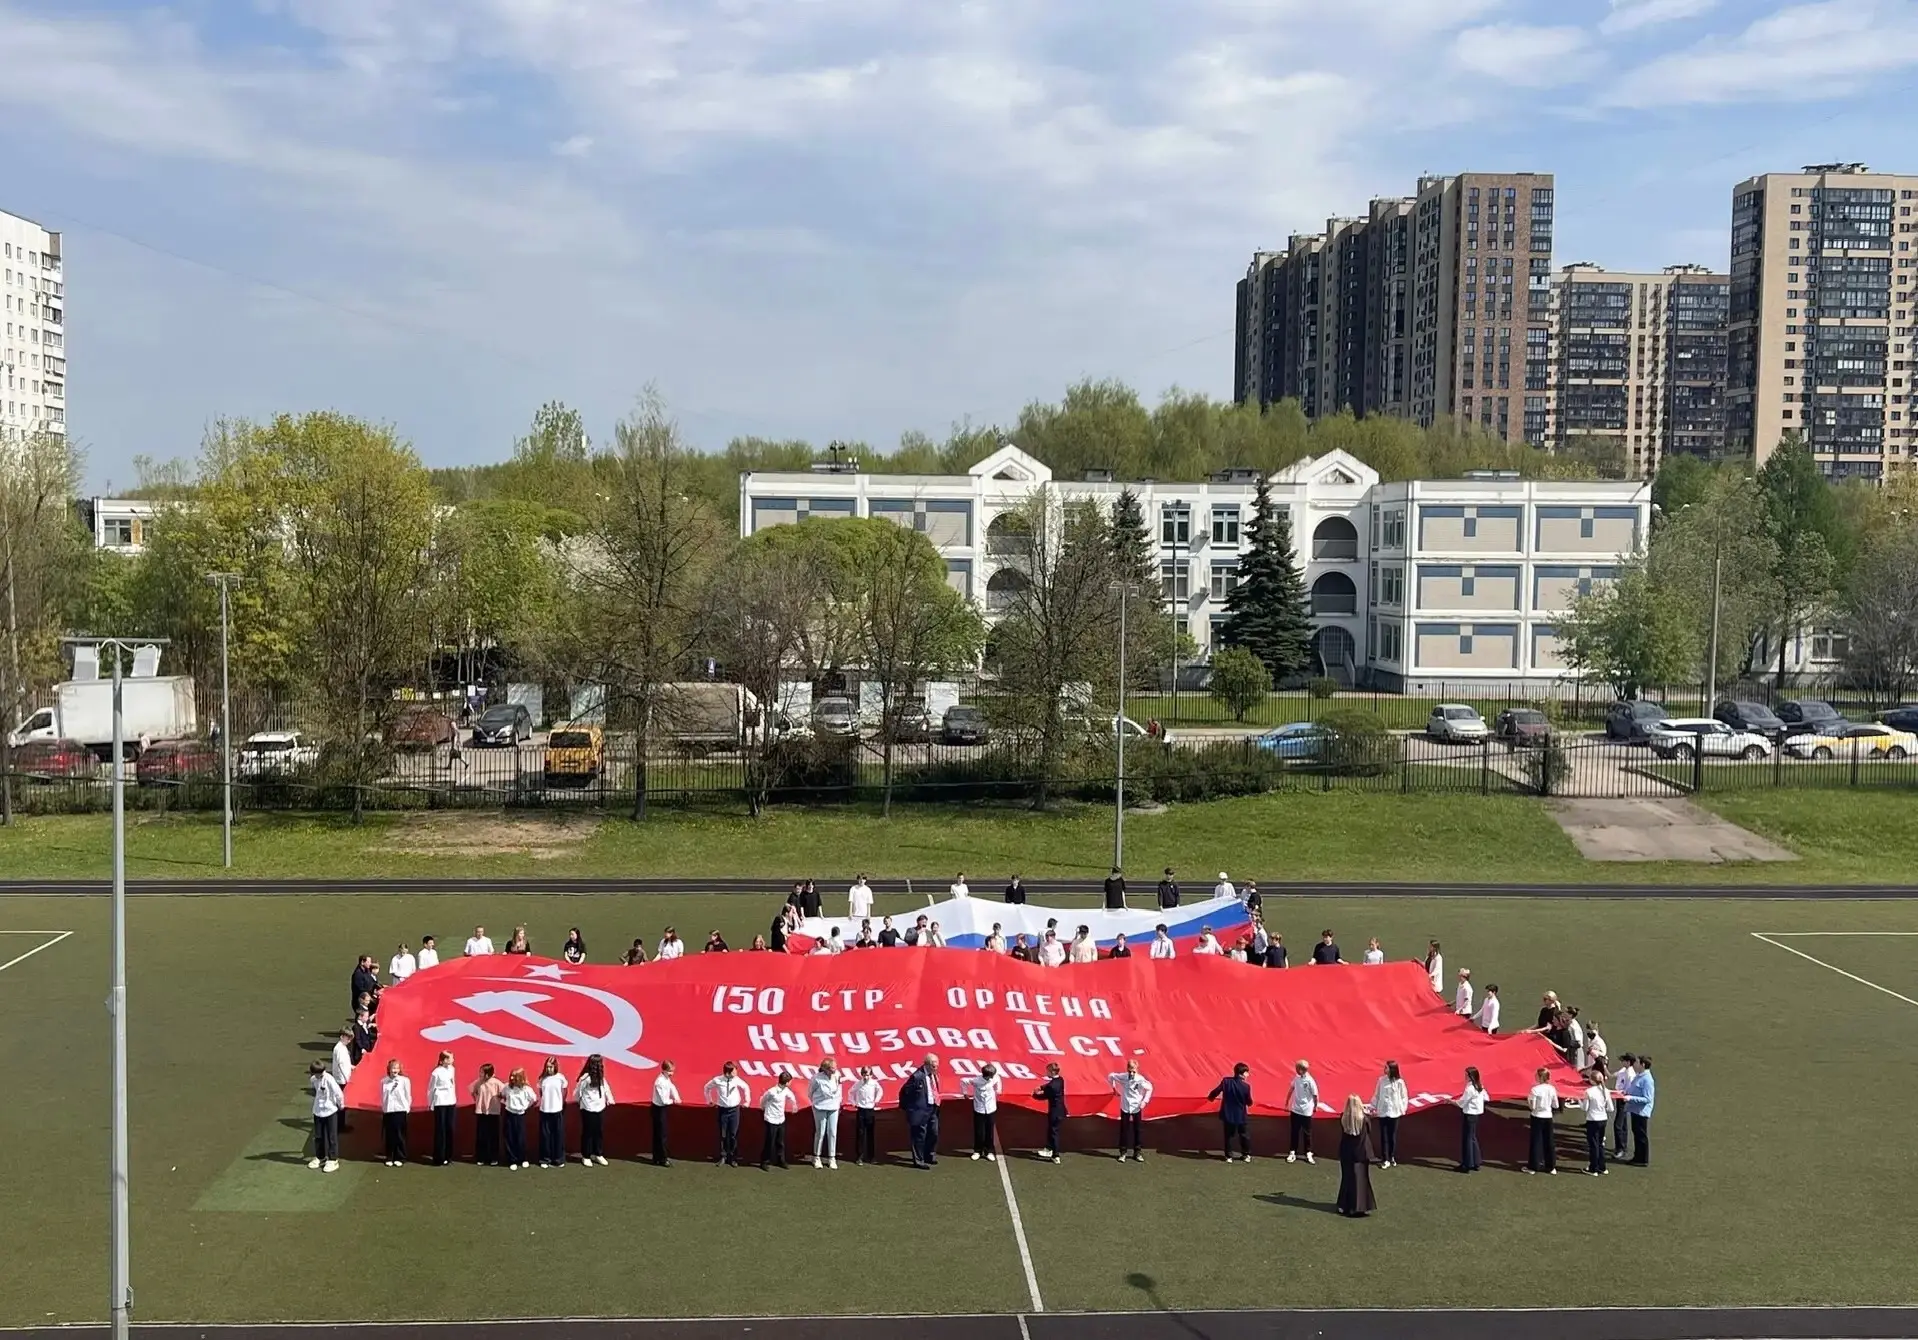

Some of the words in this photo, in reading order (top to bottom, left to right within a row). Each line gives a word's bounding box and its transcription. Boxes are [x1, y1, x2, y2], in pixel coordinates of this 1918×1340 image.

[712, 984, 785, 1015] 150
[811, 989, 903, 1012] СТР.
[947, 987, 1112, 1019] ОРДЕНА
[1015, 1018, 1066, 1056] II
[1069, 1036, 1145, 1057] СТ.
